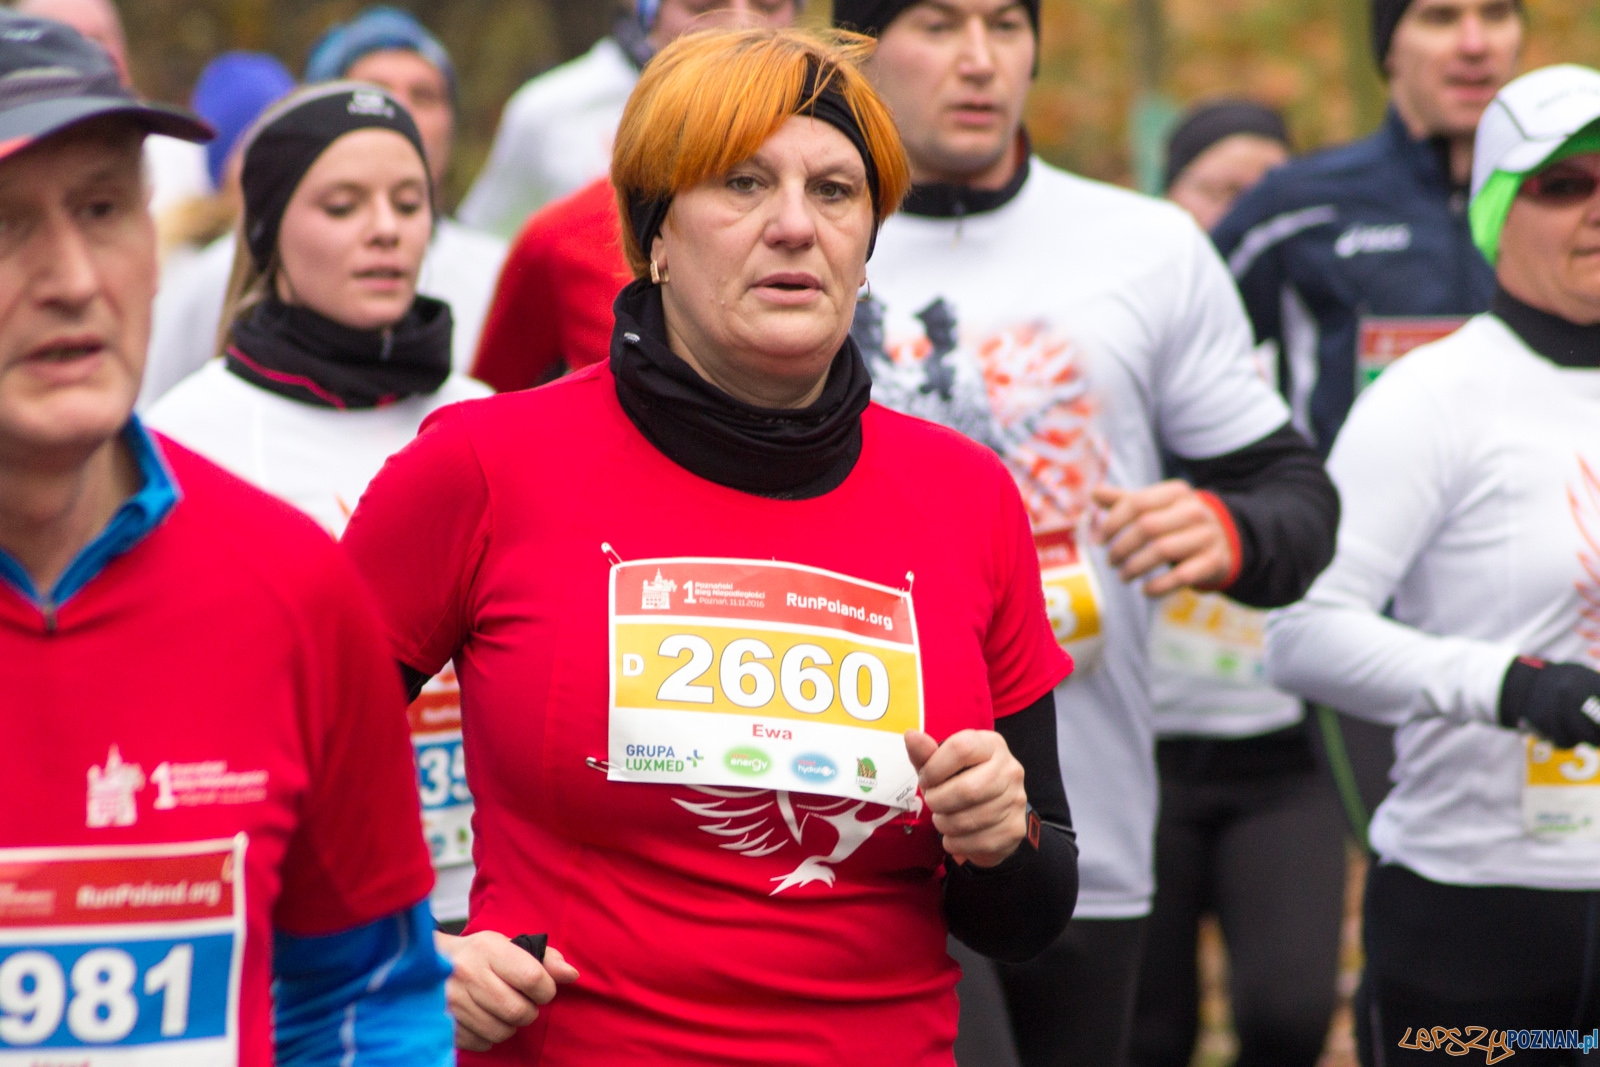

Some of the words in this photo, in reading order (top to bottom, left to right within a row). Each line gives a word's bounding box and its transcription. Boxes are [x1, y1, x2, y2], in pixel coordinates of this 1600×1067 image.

[683, 580, 697, 604] 1
[786, 592, 893, 630] RunPoland.org
[622, 653, 645, 677] D
[657, 634, 890, 721] 2660
[752, 723, 793, 741] Ewa
[626, 744, 676, 758] GRUPA
[626, 758, 684, 772] LUXMED
[730, 758, 767, 772] energy
[0, 944, 194, 1046] 981
